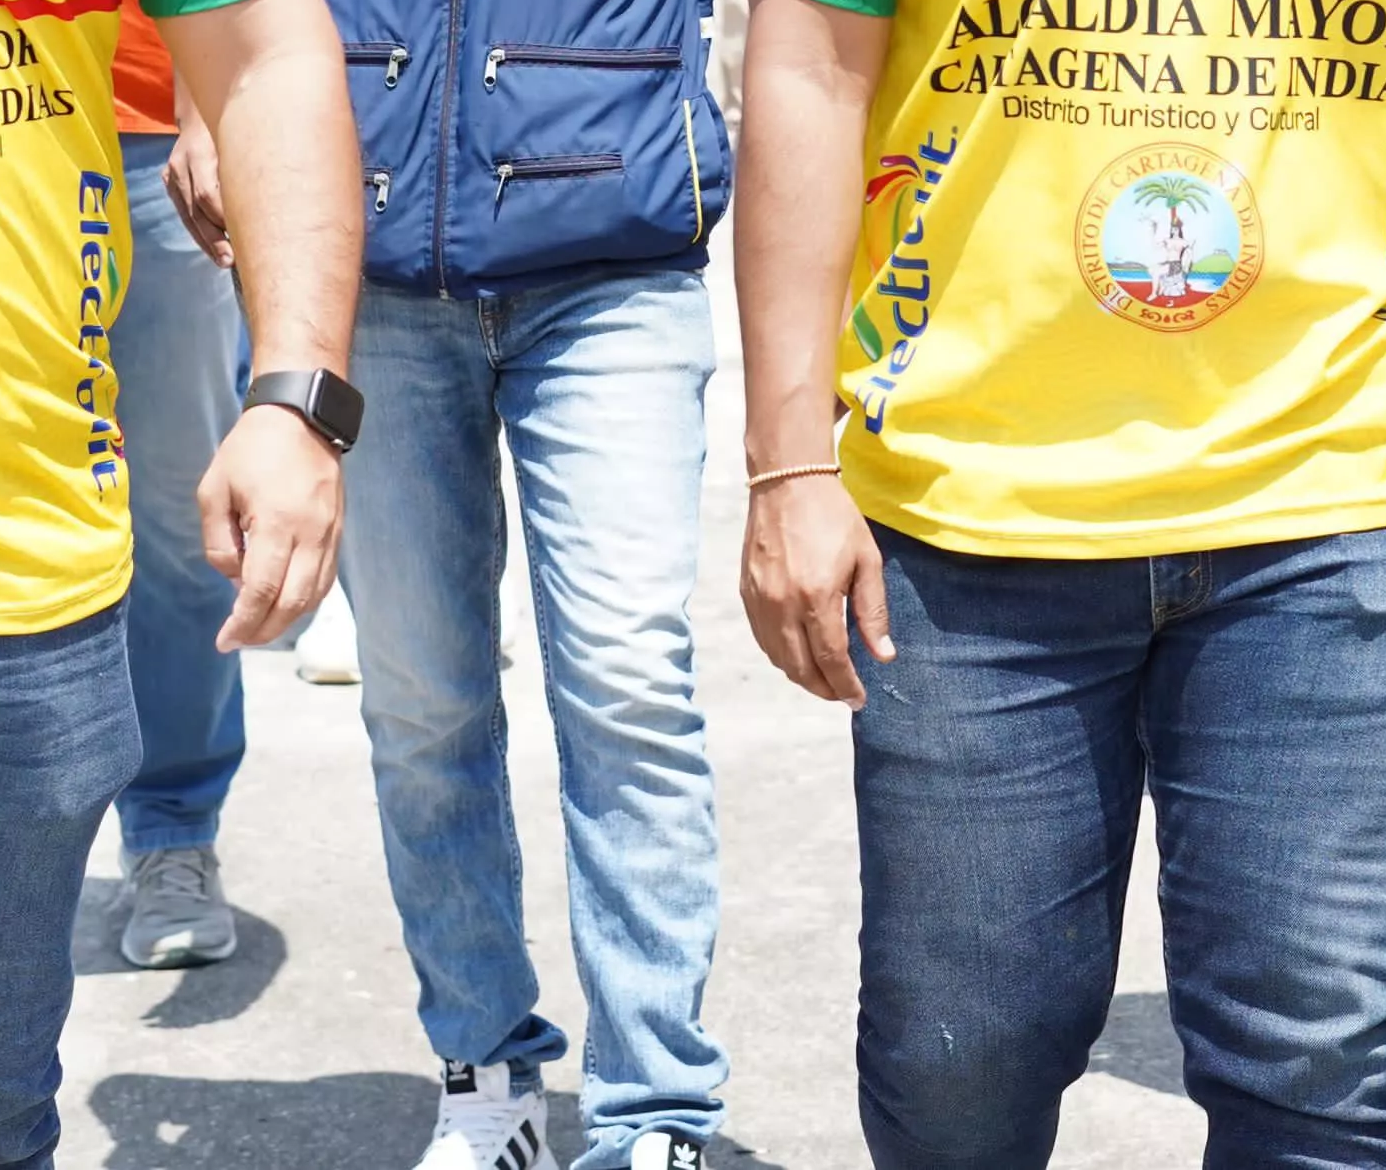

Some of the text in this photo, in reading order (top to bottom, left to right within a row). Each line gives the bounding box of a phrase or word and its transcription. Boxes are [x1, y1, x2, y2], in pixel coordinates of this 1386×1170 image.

[1206, 55, 1276, 97] DE
[1003, 94, 1089, 125] Distrito
[1099, 102, 1215, 129] Turistico
[1226, 111, 1240, 136] y
[1082, 152, 1257, 312] DISTRITO DE CARTAGENA DE INDIAS
